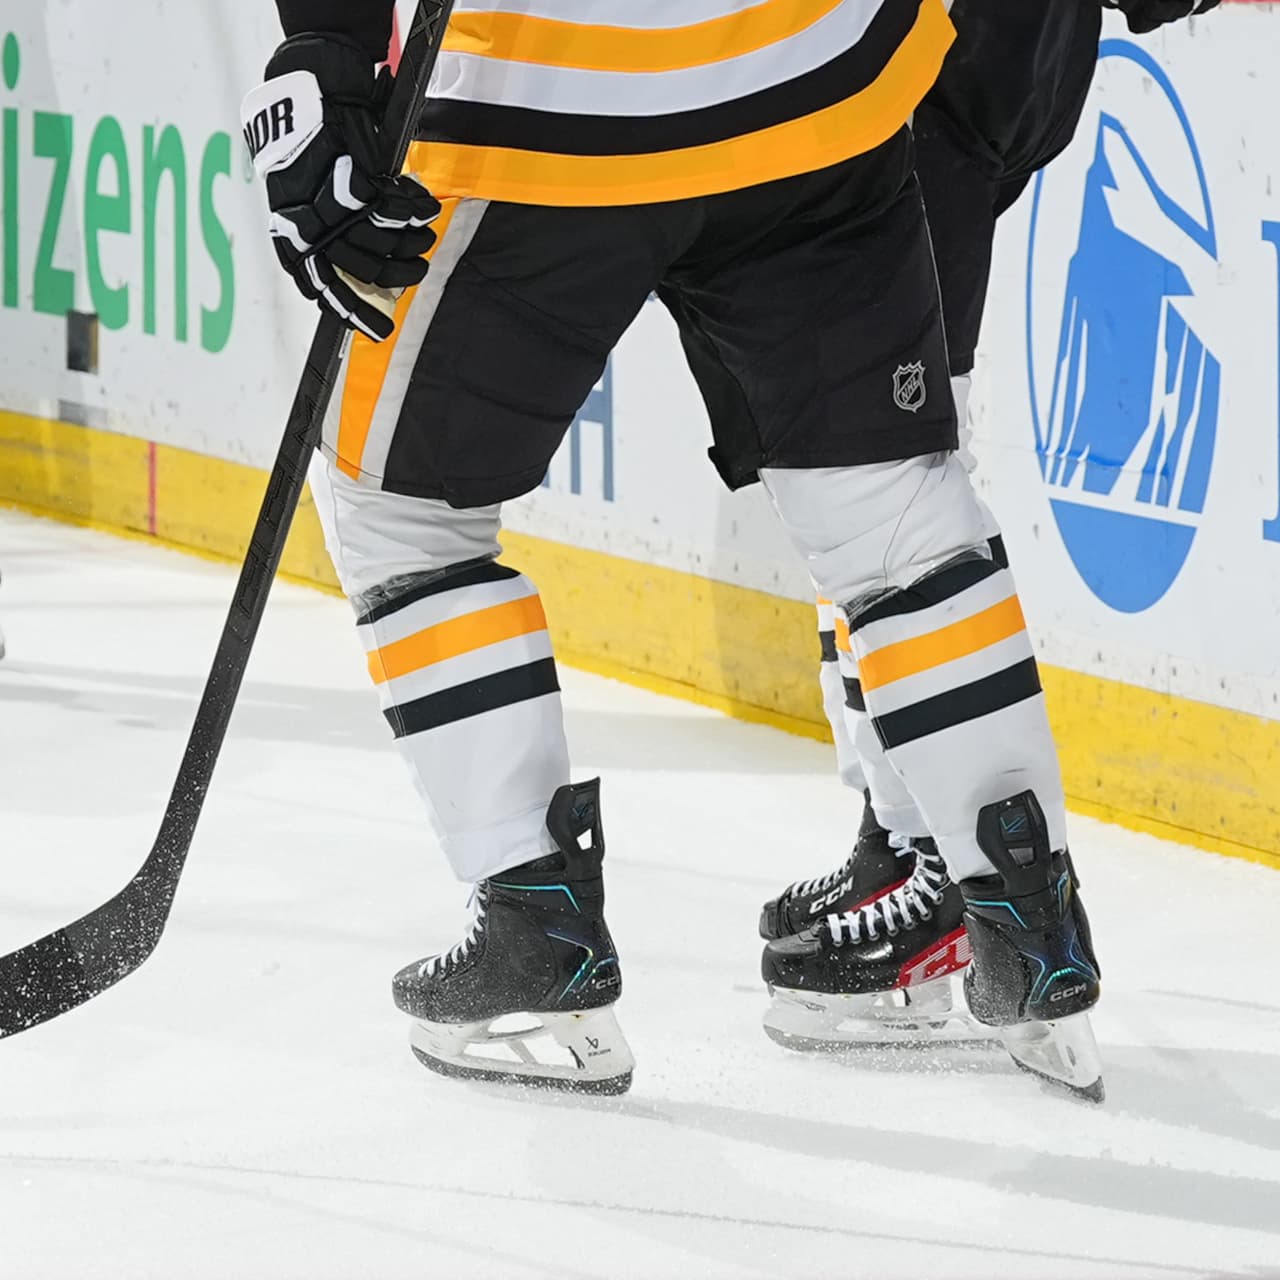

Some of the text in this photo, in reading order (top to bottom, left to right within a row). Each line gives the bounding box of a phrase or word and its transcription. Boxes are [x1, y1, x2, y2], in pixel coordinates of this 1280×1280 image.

[808, 878, 854, 915] CCM
[595, 974, 621, 990] CC
[1049, 982, 1088, 1003] CCM
